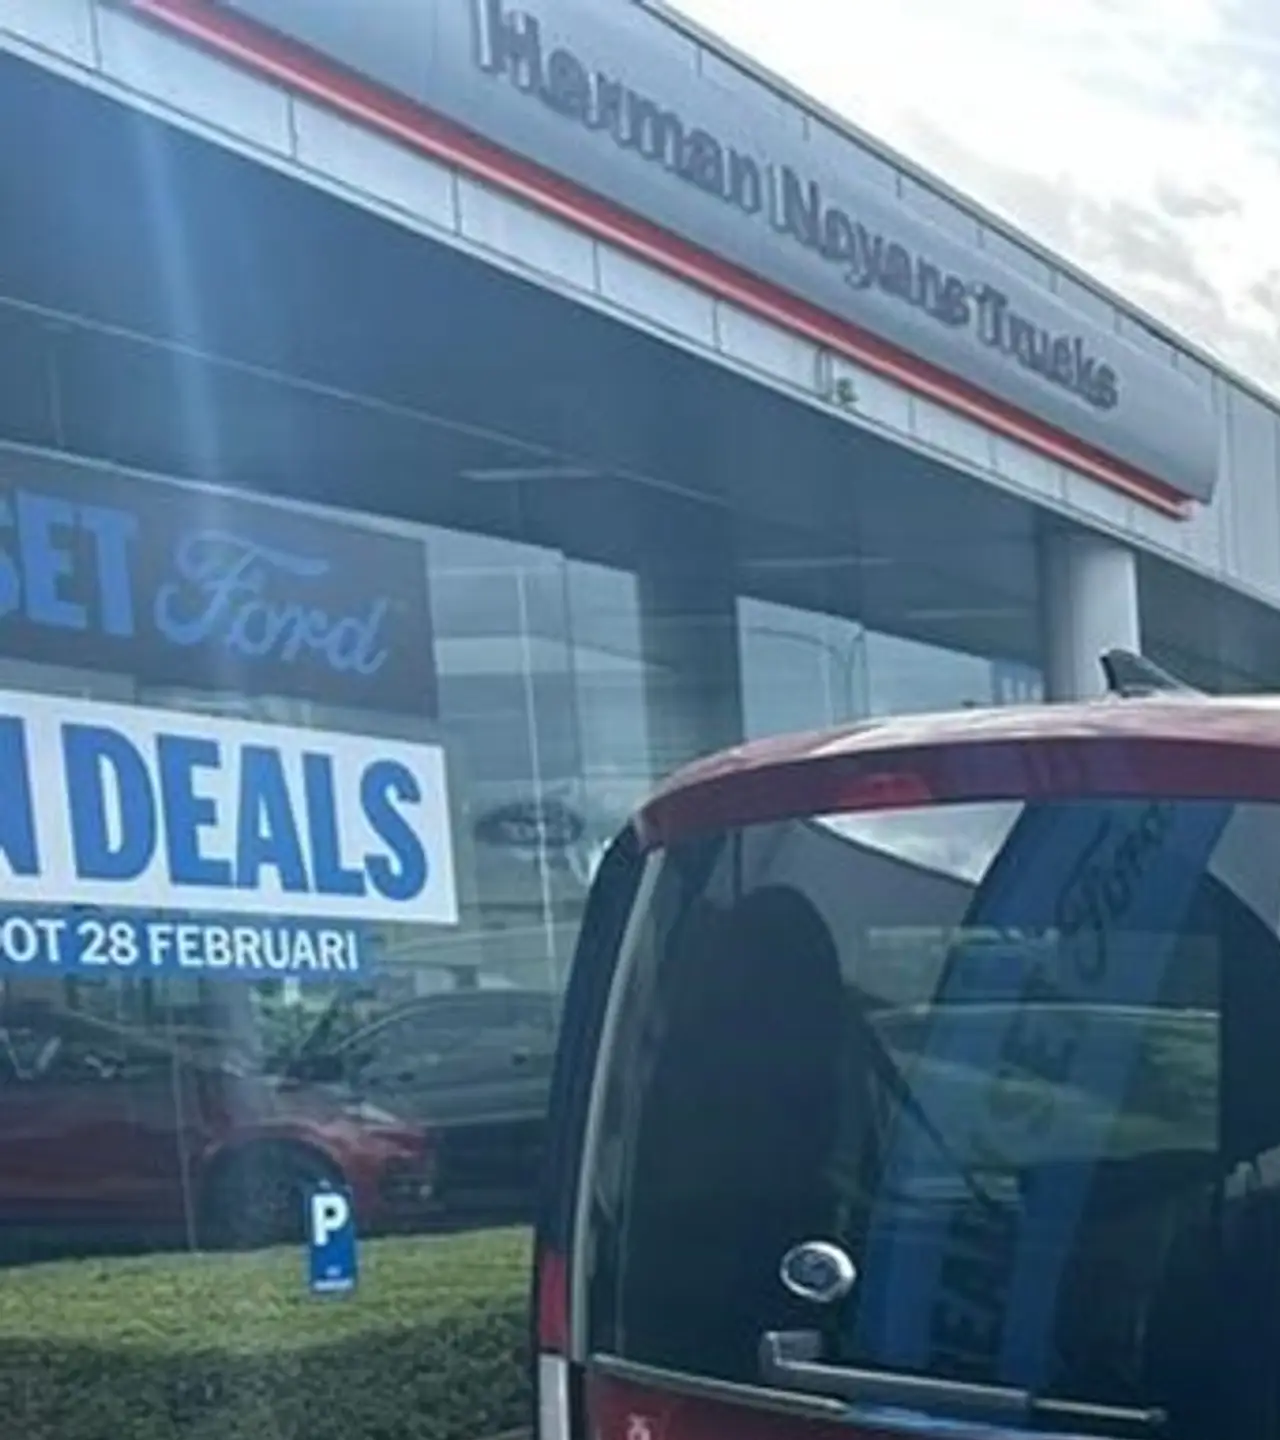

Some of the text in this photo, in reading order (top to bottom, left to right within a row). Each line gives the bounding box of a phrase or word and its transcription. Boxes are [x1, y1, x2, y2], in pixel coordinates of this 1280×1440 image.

[471, 0, 761, 215] Herman
[966, 280, 1118, 410] Trucks
[155, 528, 388, 675] Ford
[60, 722, 430, 902] DEALS
[76, 920, 139, 966] 28
[147, 923, 359, 972] FEBRUARI
[311, 1194, 348, 1247] P
